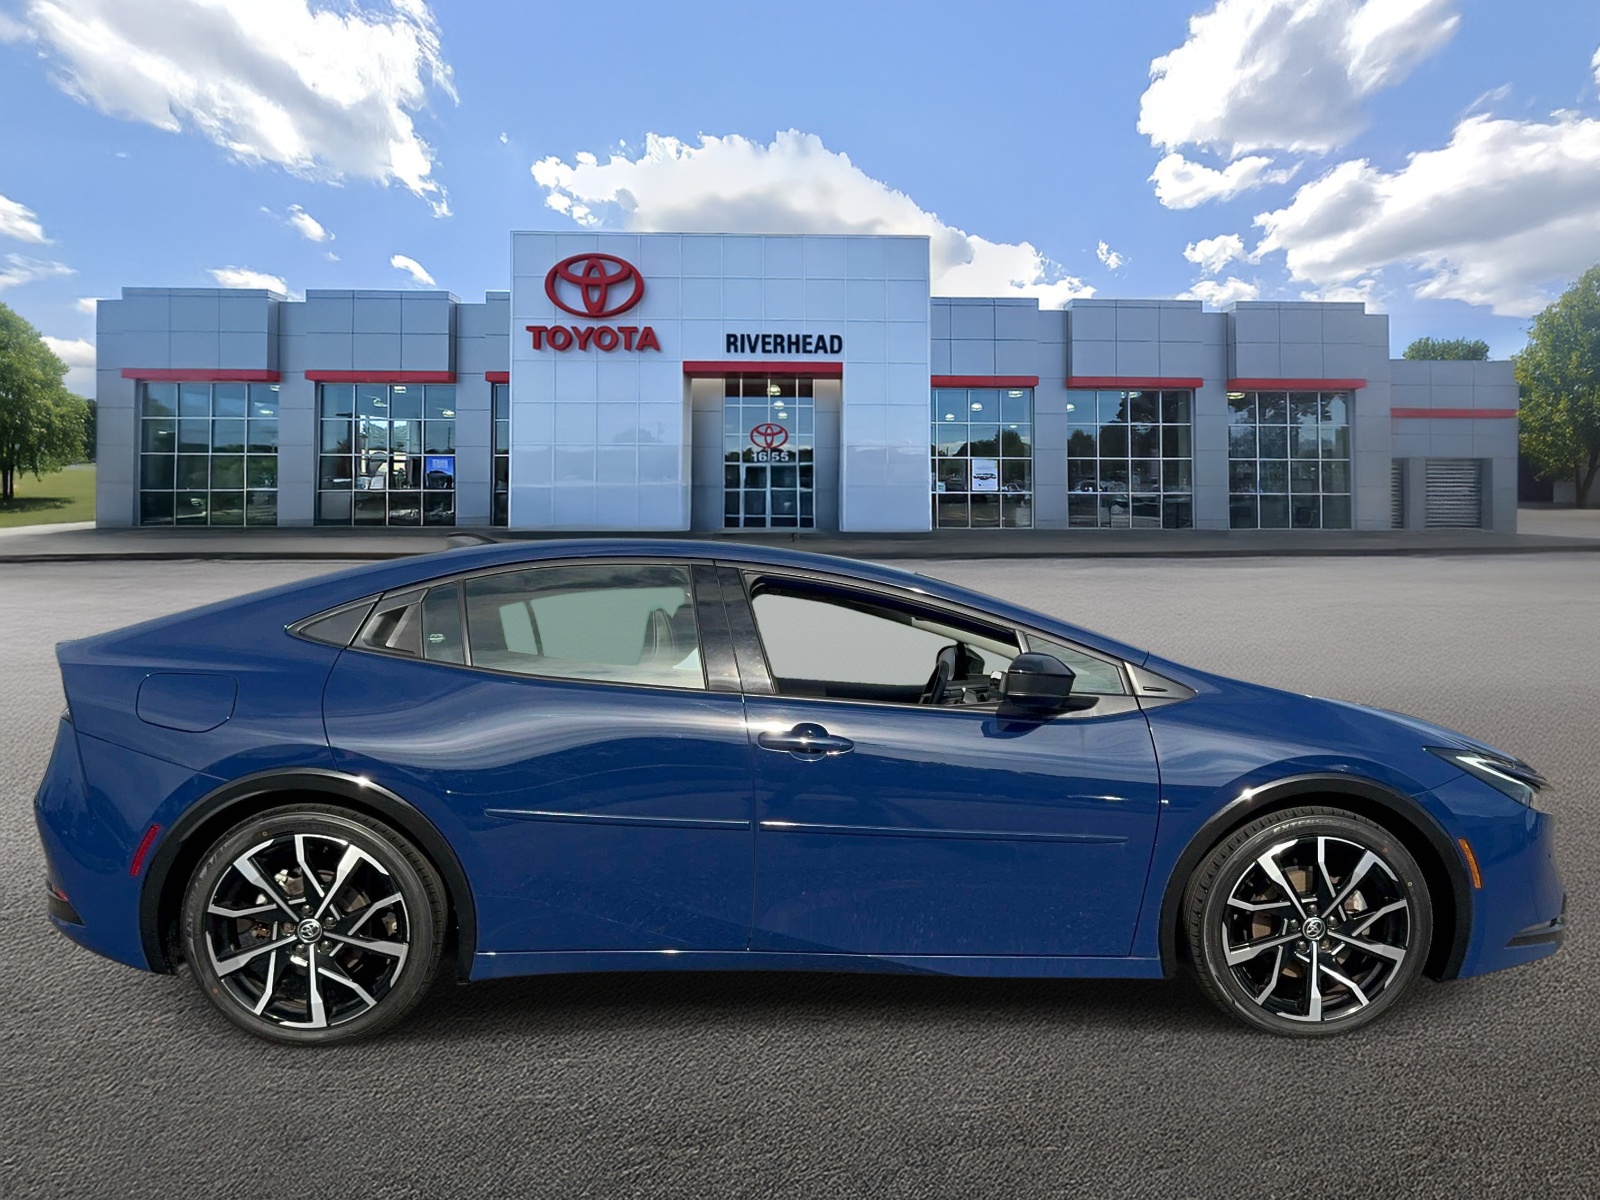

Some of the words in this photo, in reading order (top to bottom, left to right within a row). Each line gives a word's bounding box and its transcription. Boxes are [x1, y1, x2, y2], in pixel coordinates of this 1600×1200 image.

[525, 325, 661, 352] TOYOTA
[725, 333, 843, 355] RIVERHEAD
[751, 451, 789, 462] 1655
